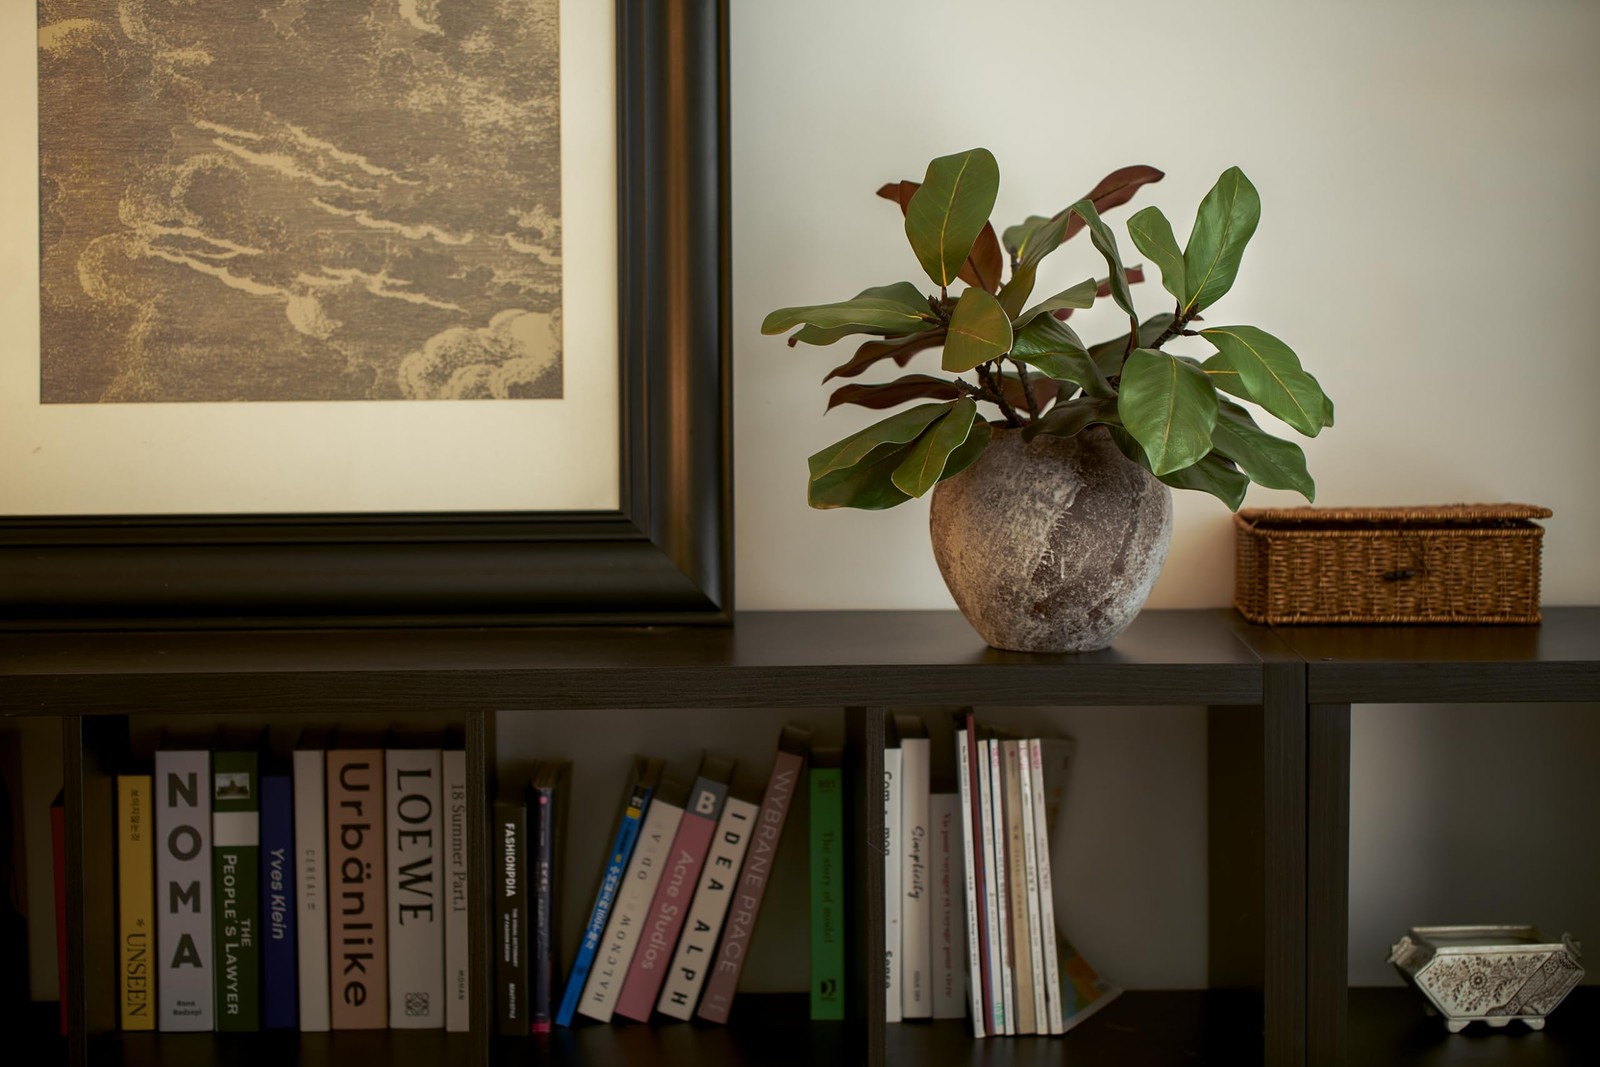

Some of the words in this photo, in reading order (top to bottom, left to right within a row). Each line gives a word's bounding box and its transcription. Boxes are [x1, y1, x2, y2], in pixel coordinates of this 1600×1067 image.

[451, 784, 465, 801] 18
[696, 789, 717, 814] B
[745, 769, 794, 887] WYBRANE
[167, 772, 203, 969] NOMA
[270, 848, 285, 892] Yves
[396, 768, 434, 926] LOEWE
[452, 804, 466, 867] Summer
[504, 822, 516, 898] FASHIONPDIA
[707, 810, 747, 892] IDEA
[822, 831, 835, 853] The
[908, 825, 925, 899] Simplicity
[222, 854, 238, 941] PEOPLE'S
[305, 849, 316, 900] CEREAL
[339, 762, 374, 1008] Urbänlike
[667, 849, 695, 898] Acne
[240, 918, 251, 948] THE
[271, 893, 284, 941] Klein
[640, 902, 678, 970] Studios
[718, 894, 758, 974] PRACE
[127, 933, 147, 1017] UNSEEN
[226, 943, 239, 1016] LAWYER
